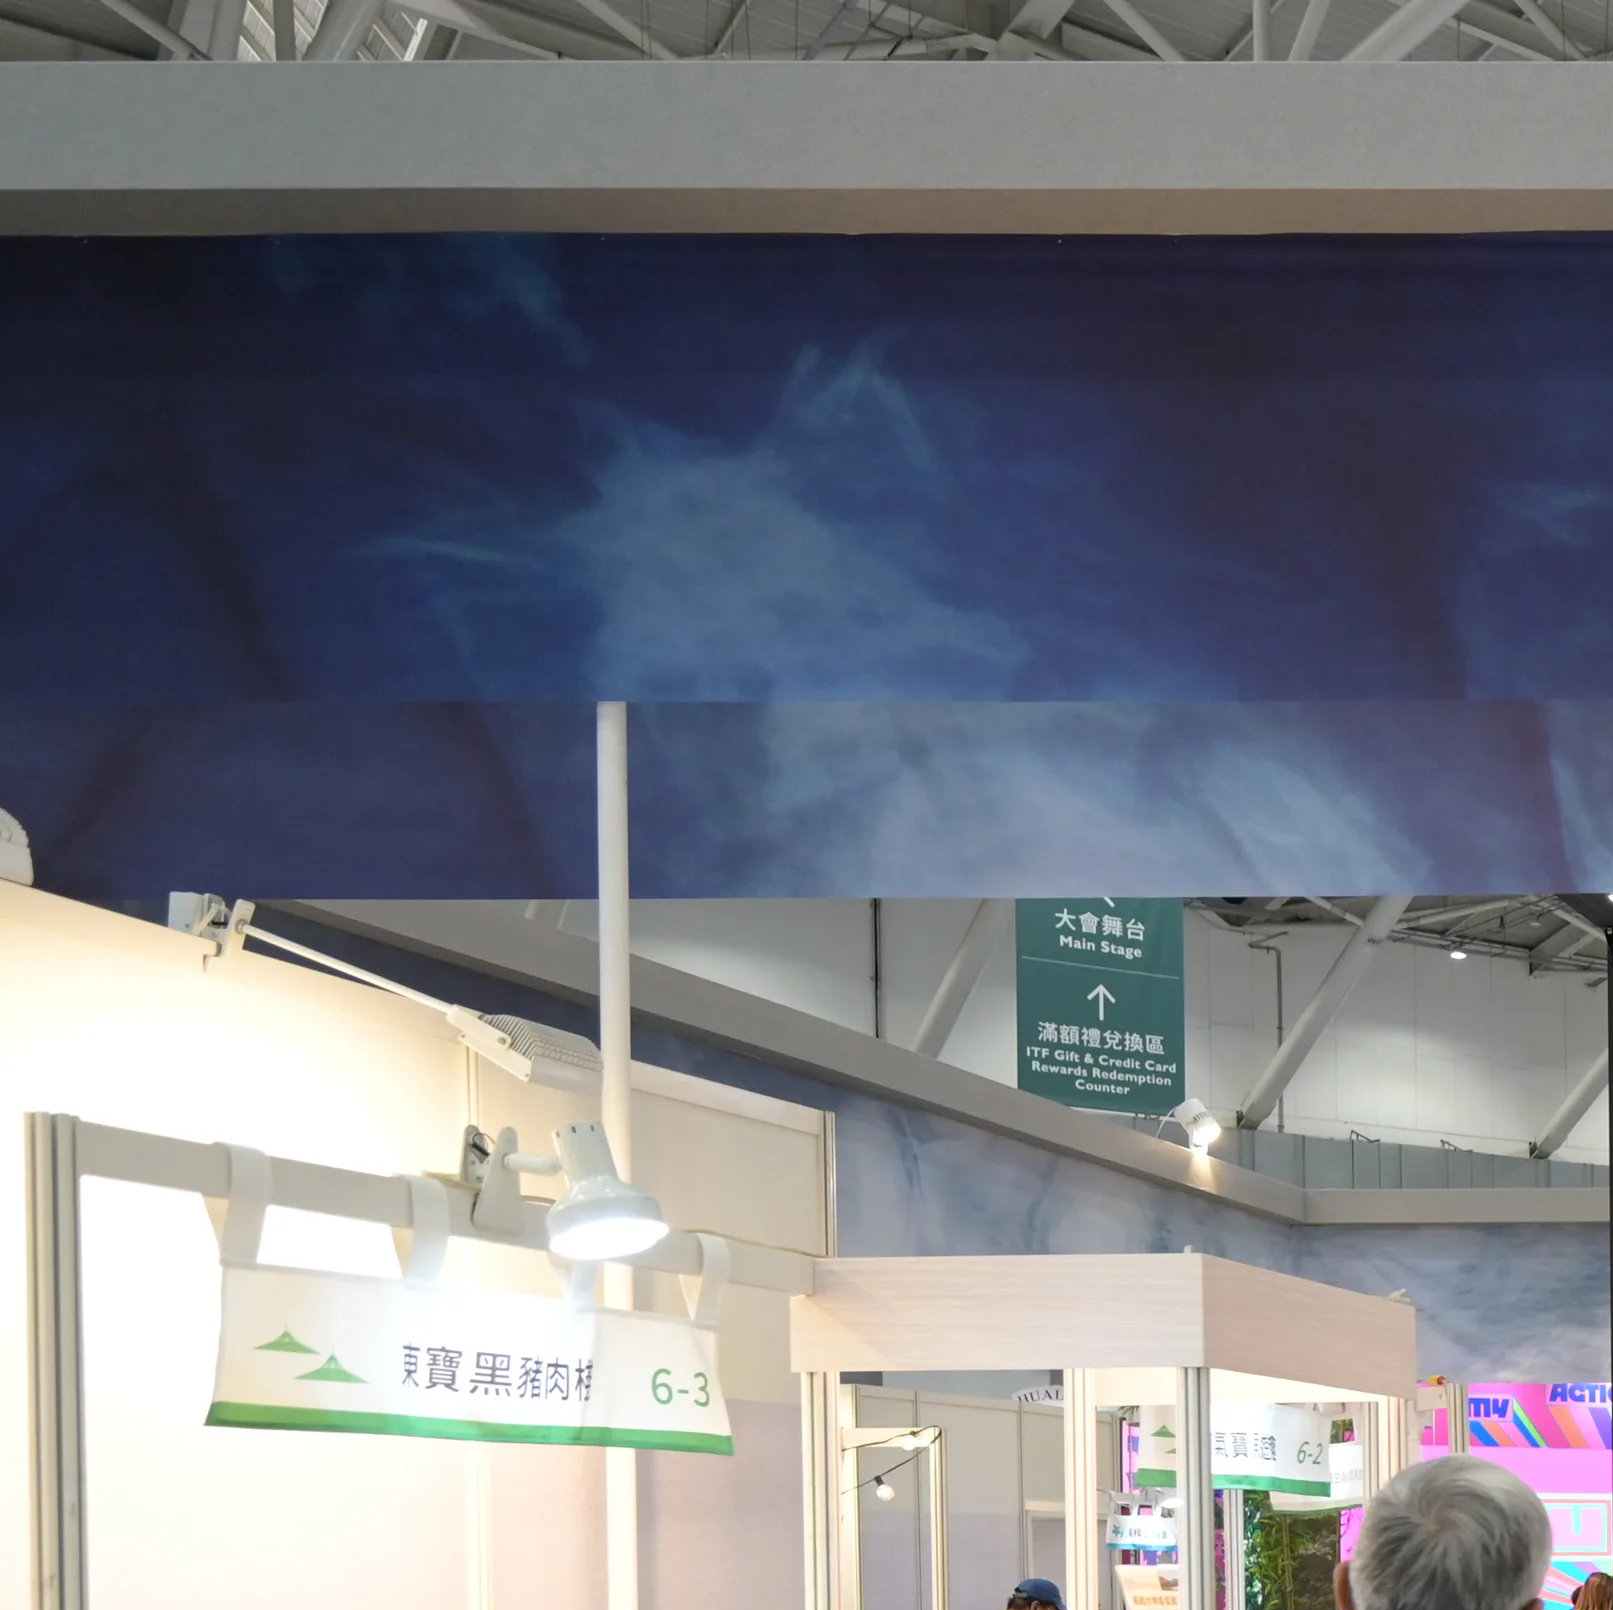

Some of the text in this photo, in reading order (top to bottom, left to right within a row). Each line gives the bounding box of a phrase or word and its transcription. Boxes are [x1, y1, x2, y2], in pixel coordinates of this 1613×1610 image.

[1054, 908, 1146, 941] 大會舞台
[1059, 935, 1143, 960] Main Stage
[1037, 1021, 1165, 1055] 滿額禮兌換區
[1026, 1046, 1177, 1074] ITF Gift & Credit Card
[1031, 1060, 1172, 1087] Rewards Redemption
[1075, 1079, 1130, 1095] Counter
[651, 1367, 711, 1407] 6-3
[1296, 1441, 1323, 1465] 6-2
